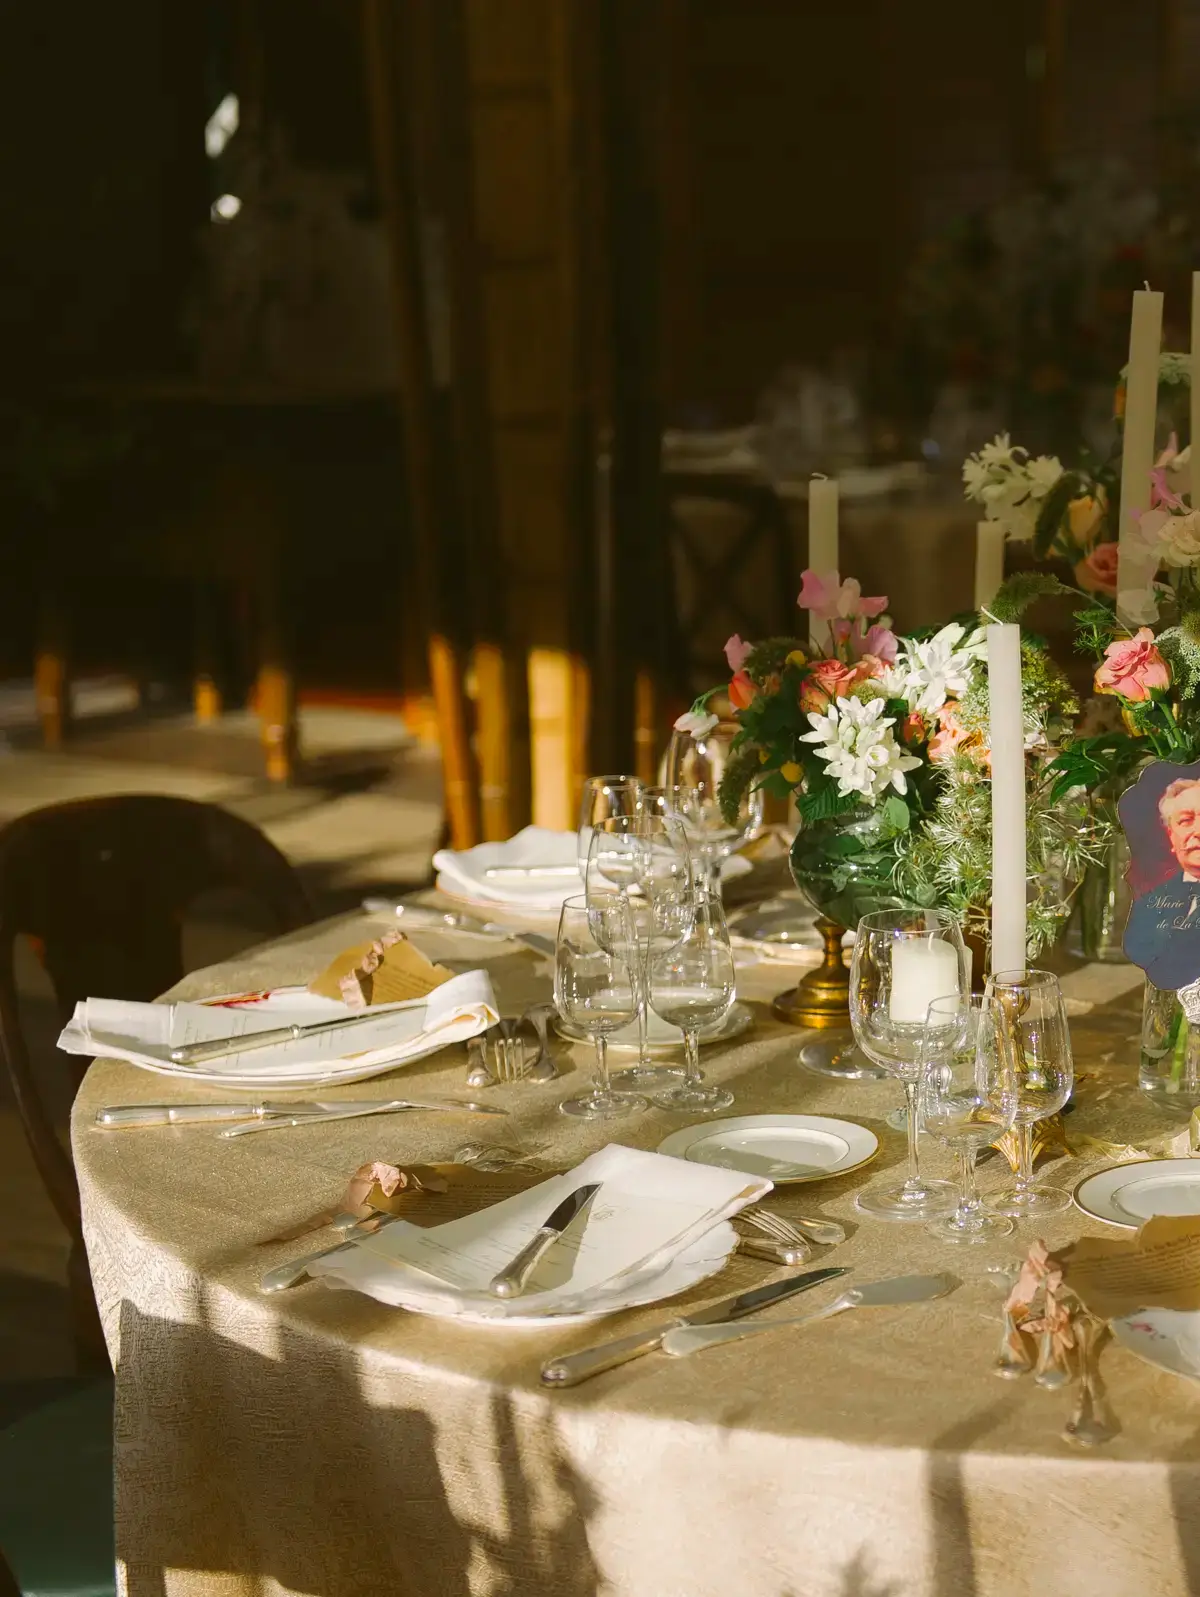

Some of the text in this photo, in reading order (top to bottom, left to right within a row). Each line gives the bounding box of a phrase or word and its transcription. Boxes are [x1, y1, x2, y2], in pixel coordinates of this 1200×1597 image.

[1146, 895, 1185, 909] Marie
[1156, 918, 1169, 929] de
[1171, 915, 1193, 930] La
